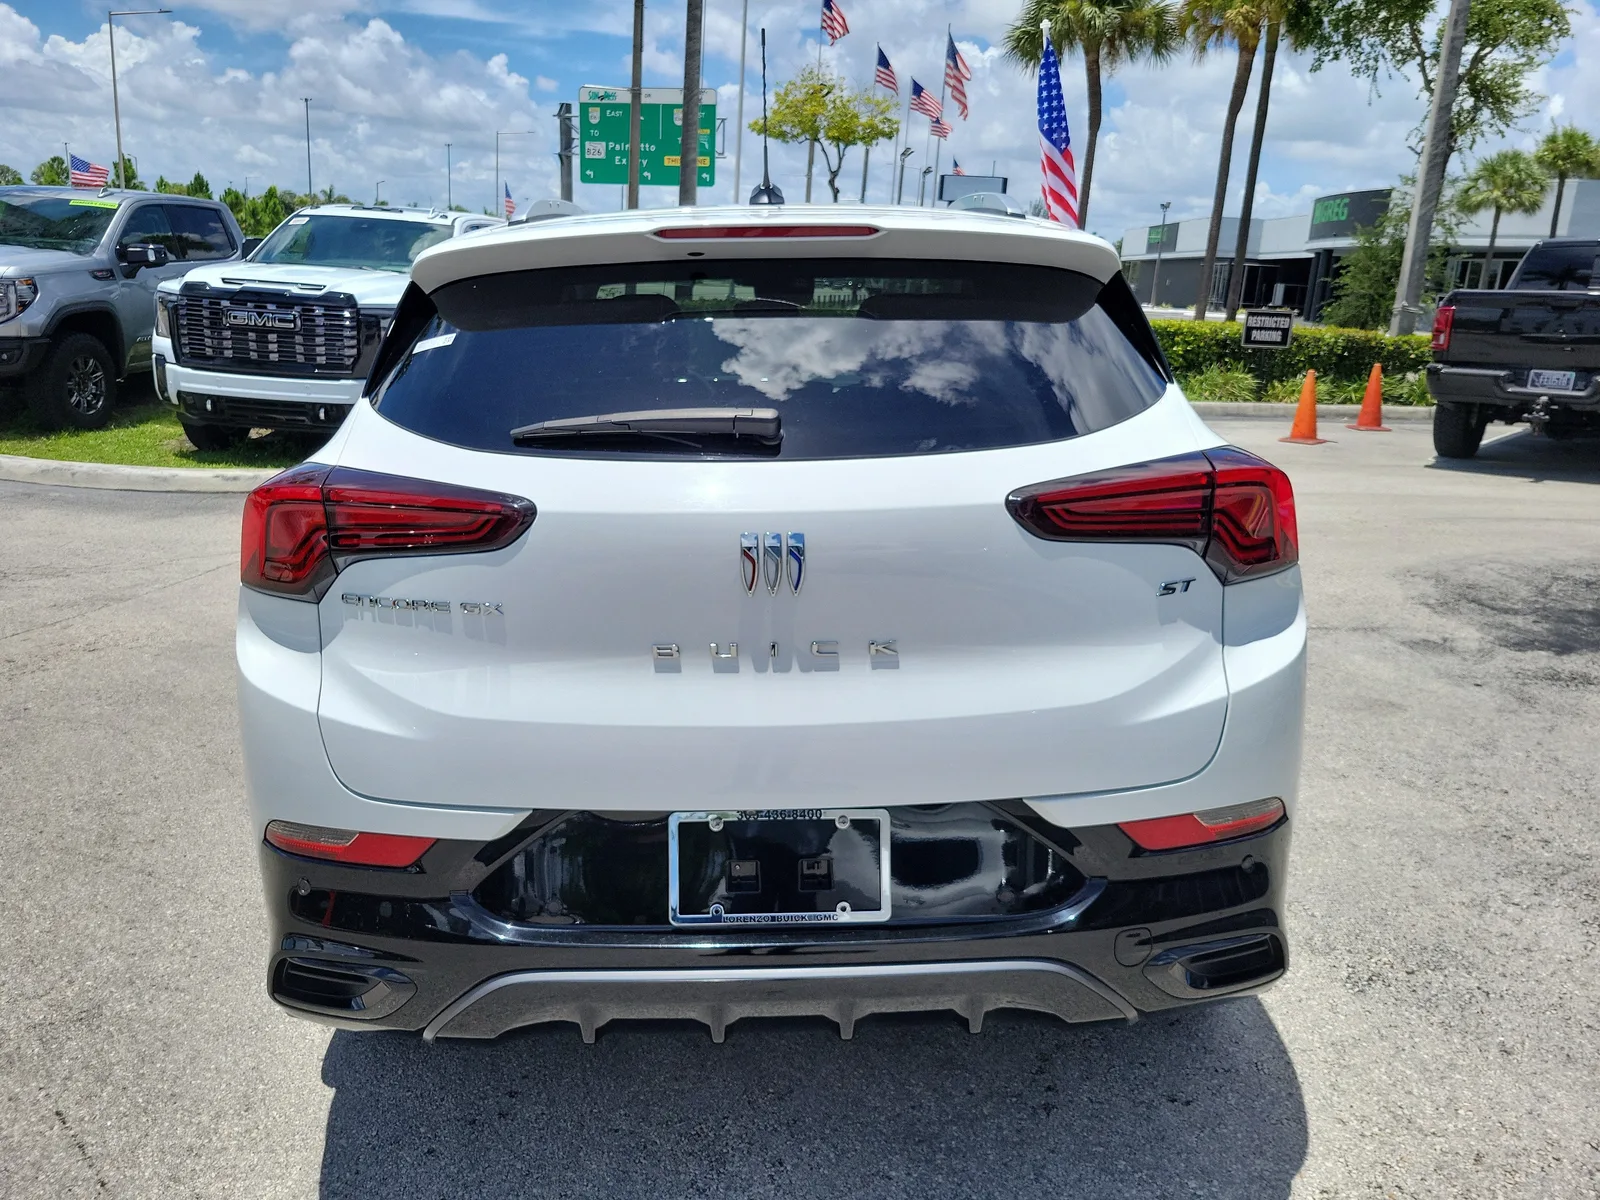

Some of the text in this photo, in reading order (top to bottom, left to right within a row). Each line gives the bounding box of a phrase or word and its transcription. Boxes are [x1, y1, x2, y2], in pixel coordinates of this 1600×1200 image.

[608, 142, 656, 152] Paltto
[227, 310, 295, 329] GMC
[1247, 315, 1290, 329] RESTRICTED
[1251, 329, 1282, 342] PARKING
[1156, 577, 1197, 597] ST
[341, 593, 504, 616] ENCORE GX
[653, 640, 898, 658] BUICK
[722, 913, 839, 923] LORENZO BUICK GMC
